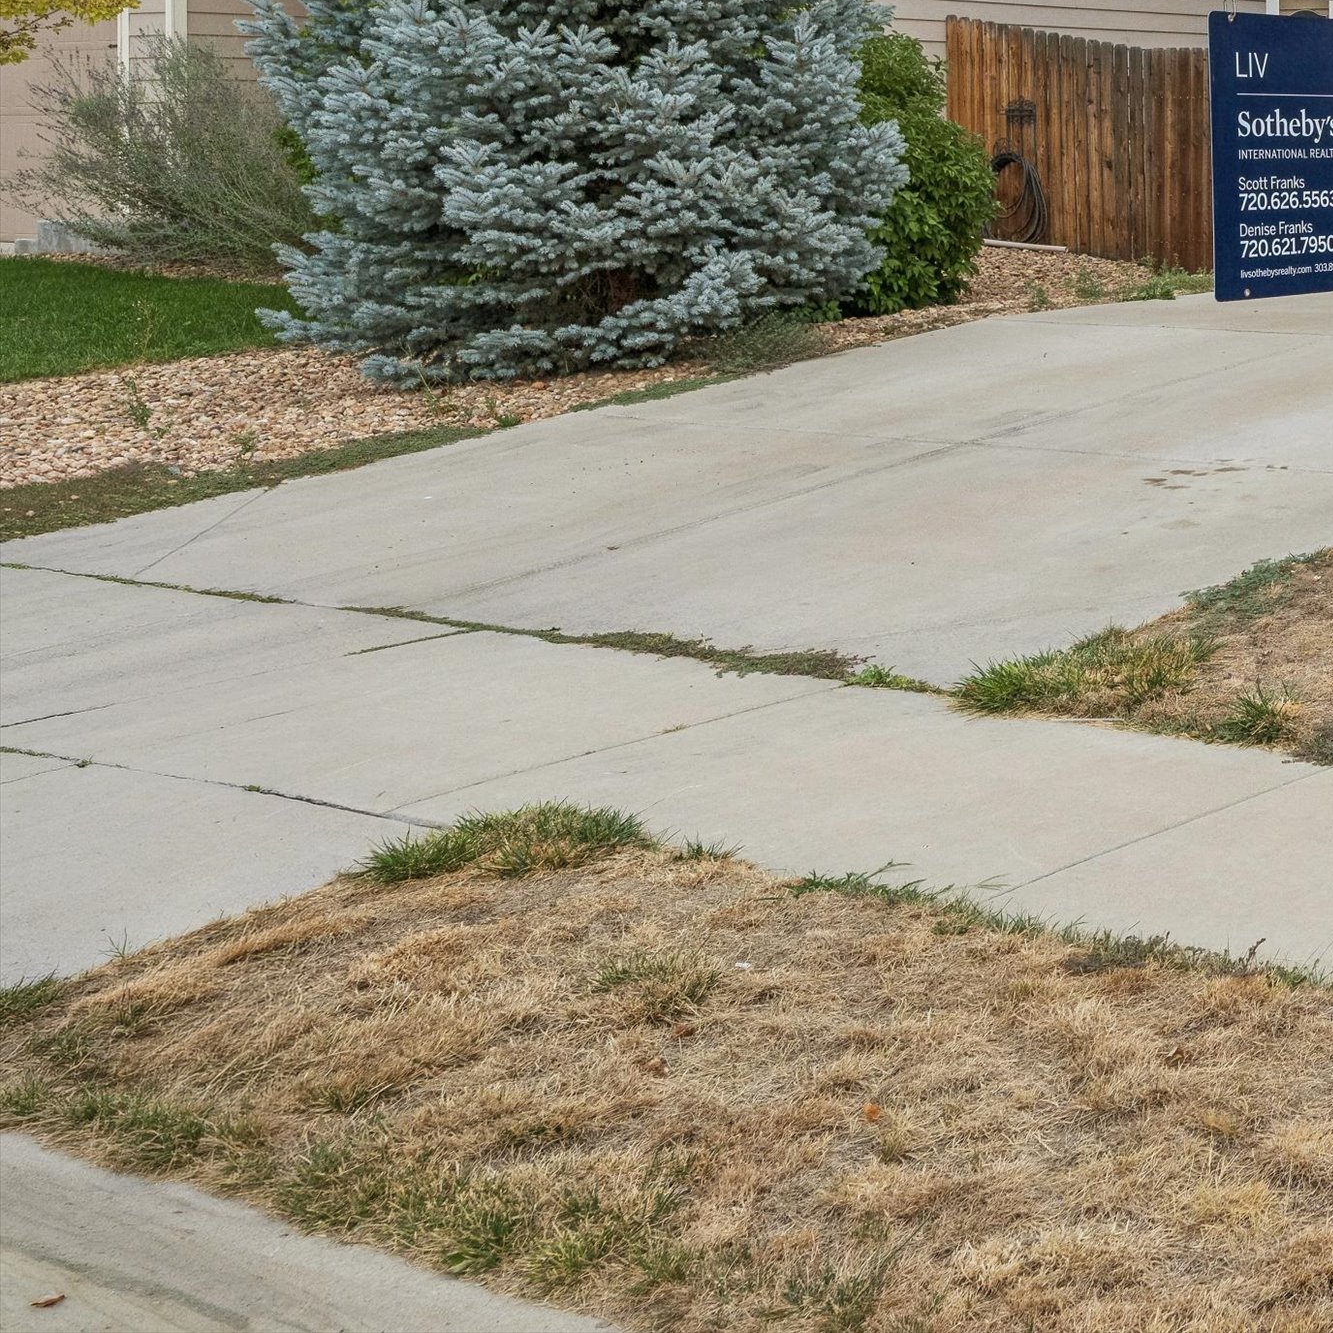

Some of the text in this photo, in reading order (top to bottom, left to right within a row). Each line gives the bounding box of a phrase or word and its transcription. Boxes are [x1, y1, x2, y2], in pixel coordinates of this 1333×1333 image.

[1235, 52, 1268, 78] LIV
[1238, 149, 1308, 160] INTERNATIONAL
[1238, 176, 1305, 191] Scott Franks
[1239, 221, 1313, 237] Denise Franks
[1240, 266, 1312, 279] livsothebysrealty.com
